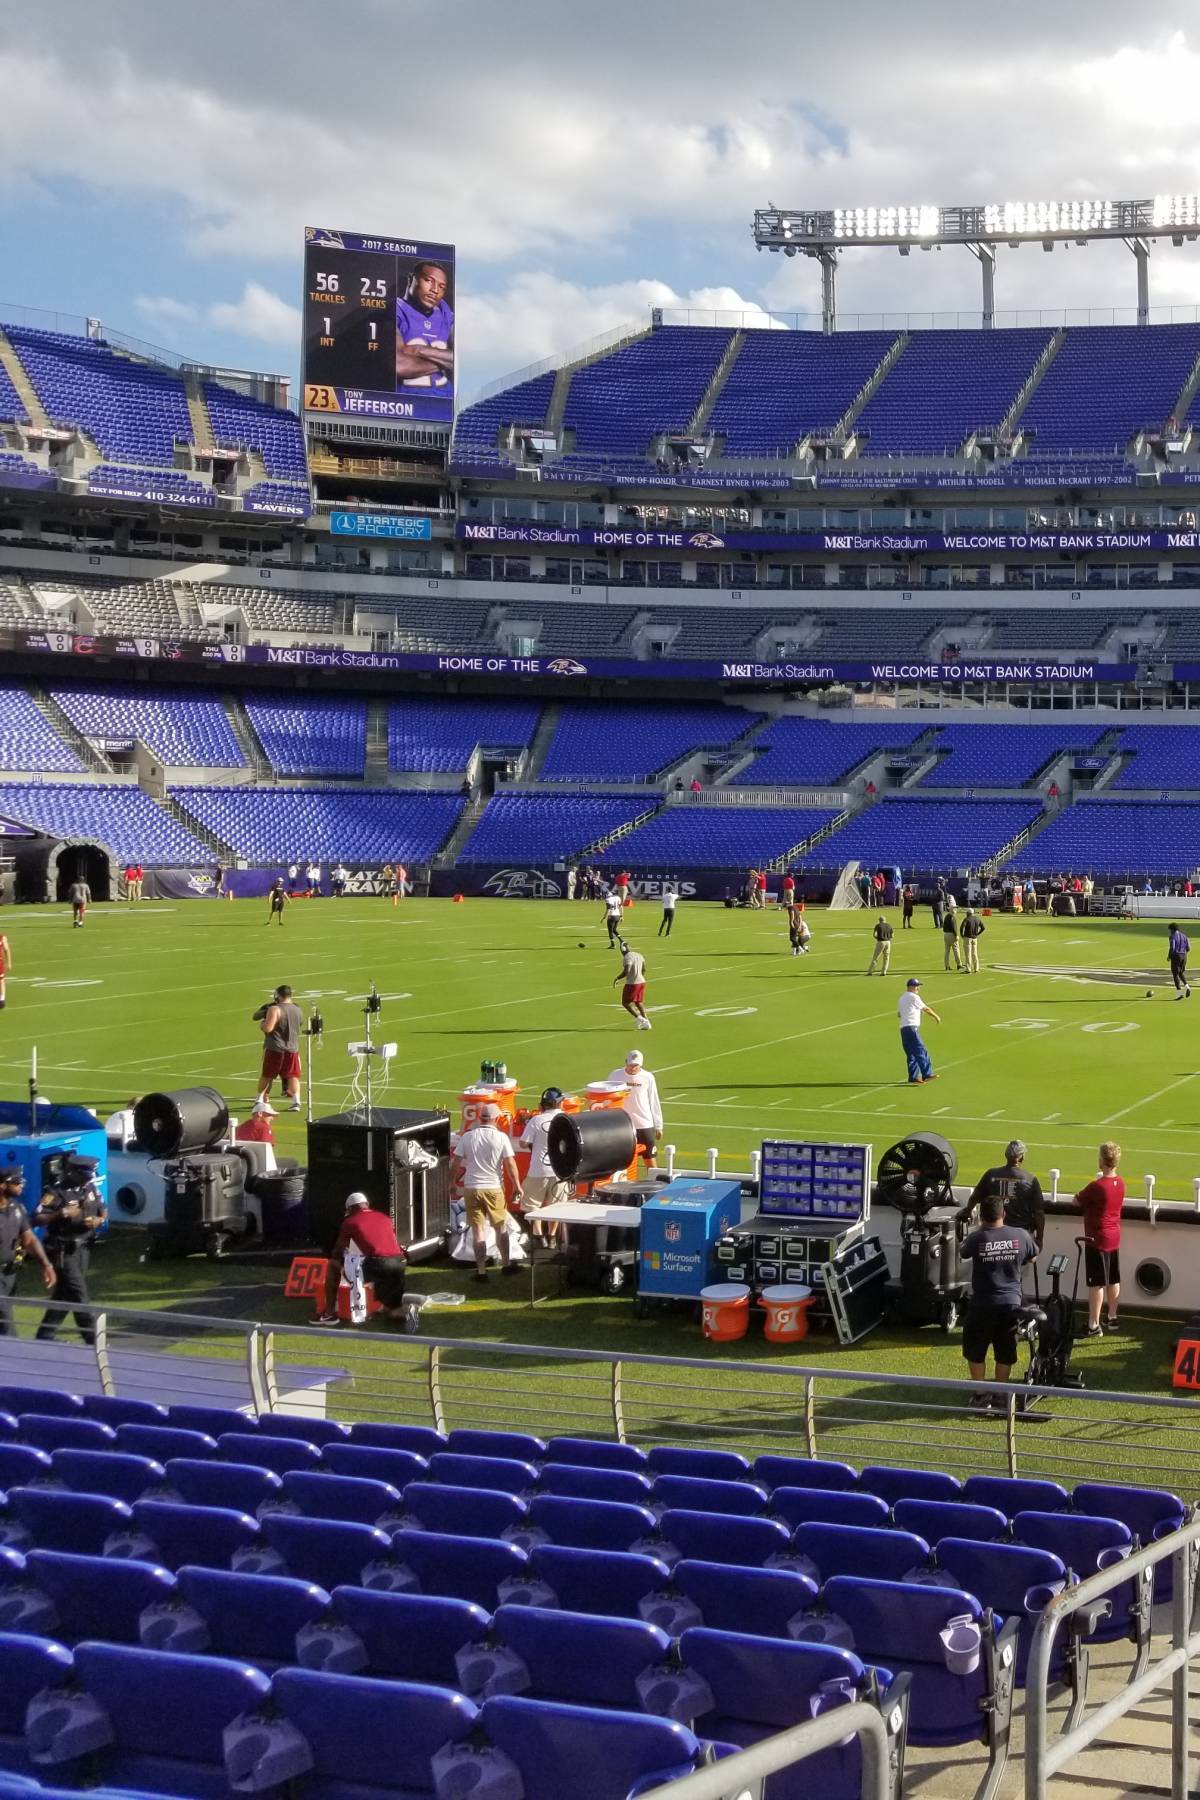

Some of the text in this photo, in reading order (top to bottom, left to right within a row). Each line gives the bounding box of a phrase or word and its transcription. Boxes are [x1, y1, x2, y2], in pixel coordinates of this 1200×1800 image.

[362, 240, 417, 254] 2017 SEASON
[316, 272, 338, 292] 56
[360, 277, 386, 298] 2.5
[310, 292, 345, 304] TACKLES
[360, 298, 386, 309] SACKS
[324, 317, 330, 336] 1
[369, 322, 376, 340] 1
[320, 337, 334, 347] INT
[368, 342, 379, 351] FF
[308, 387, 330, 409] 23
[344, 390, 363, 400] TONY
[344, 398, 413, 416] JEFFERSON
[616, 476, 636, 485] RING
[649, 478, 677, 486] HONOR
[692, 478, 790, 488] EARNEST BYNER 1996-2003
[938, 478, 1006, 486] ARTHUR B. MODELL
[1024, 476, 1132, 486] MICHAEL McCRARY 1997-2002
[89, 486, 108, 494] TEXT
[108, 488, 122, 496] FOR
[124, 490, 142, 498] HELP
[252, 502, 304, 515] RAVENS
[357, 515, 424, 528] STRATEGIC
[357, 525, 424, 538] FACTORY
[465, 525, 580, 543] M&T Bank Stadium
[594, 532, 682, 546] HOME OF THE
[824, 536, 928, 549] M&T Bank Stadium
[944, 535, 1150, 548] WELCOME TO M&T BANK STADIUM
[1168, 534, 1198, 546] M&T
[267, 649, 398, 668] M&T Bank Stadium
[439, 658, 540, 672] HOME OF THE
[722, 664, 834, 679] M&T Bank Stadium
[872, 665, 1093, 679] WELCOME TO M&T BANK STADIUM
[464, 1104, 477, 1120] G
[666, 1230, 680, 1240] NFL
[663, 1252, 700, 1263] Microsoft
[663, 1262, 693, 1272] Surface
[704, 1308, 712, 1320] G
[778, 1310, 790, 1323] G
